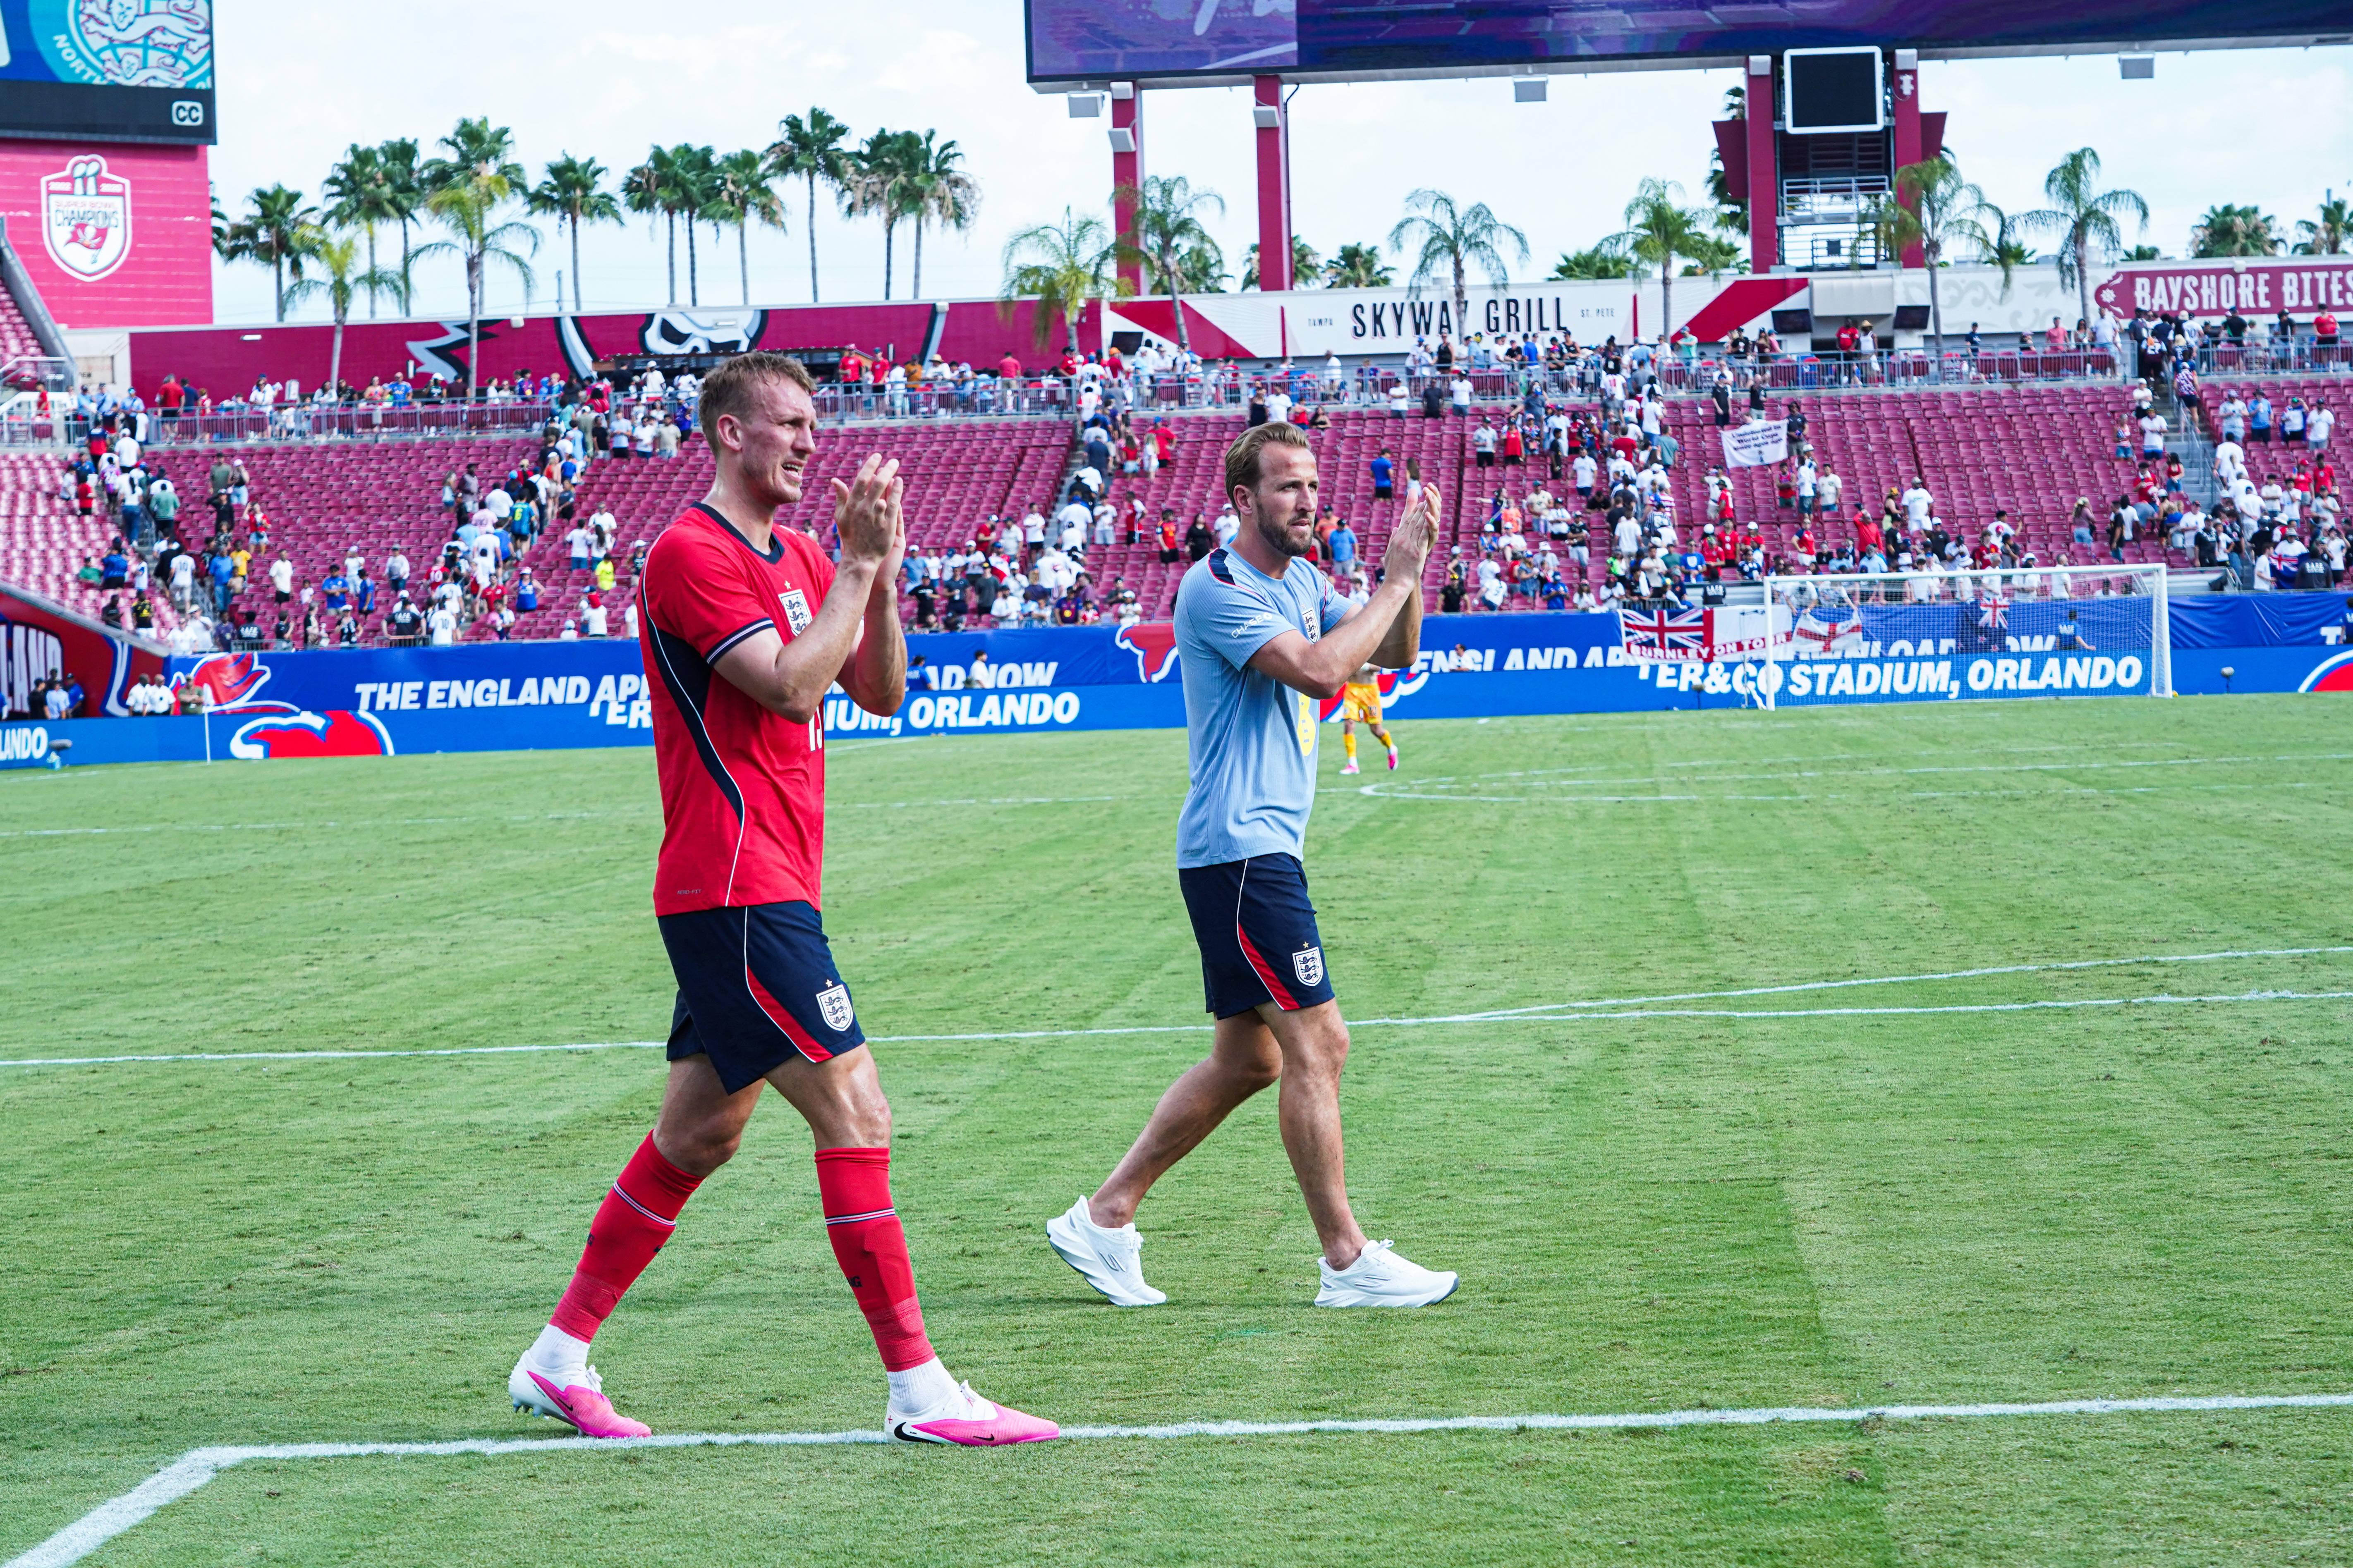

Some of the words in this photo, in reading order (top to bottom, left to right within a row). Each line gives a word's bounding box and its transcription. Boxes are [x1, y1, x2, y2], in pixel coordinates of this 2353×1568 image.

[176, 105, 200, 123] CC
[55, 209, 118, 228] CHAMPIONS
[2134, 273, 2271, 311] BAYSHORE
[1307, 318, 1333, 327] TAMPA
[1485, 296, 1567, 334] GRILL
[1596, 307, 1615, 317] PETE
[1231, 615, 1264, 638] CHASE
[1630, 644, 1710, 659] BURNLEY
[1713, 642, 1738, 656] ON
[1740, 632, 1787, 651] TOR
[354, 681, 424, 711] THE
[426, 676, 590, 709] ENGLAND
[1788, 660, 1960, 699] STADIUM,
[1968, 655, 2143, 691] ORLANDO
[909, 691, 1080, 729] ORLANDO
